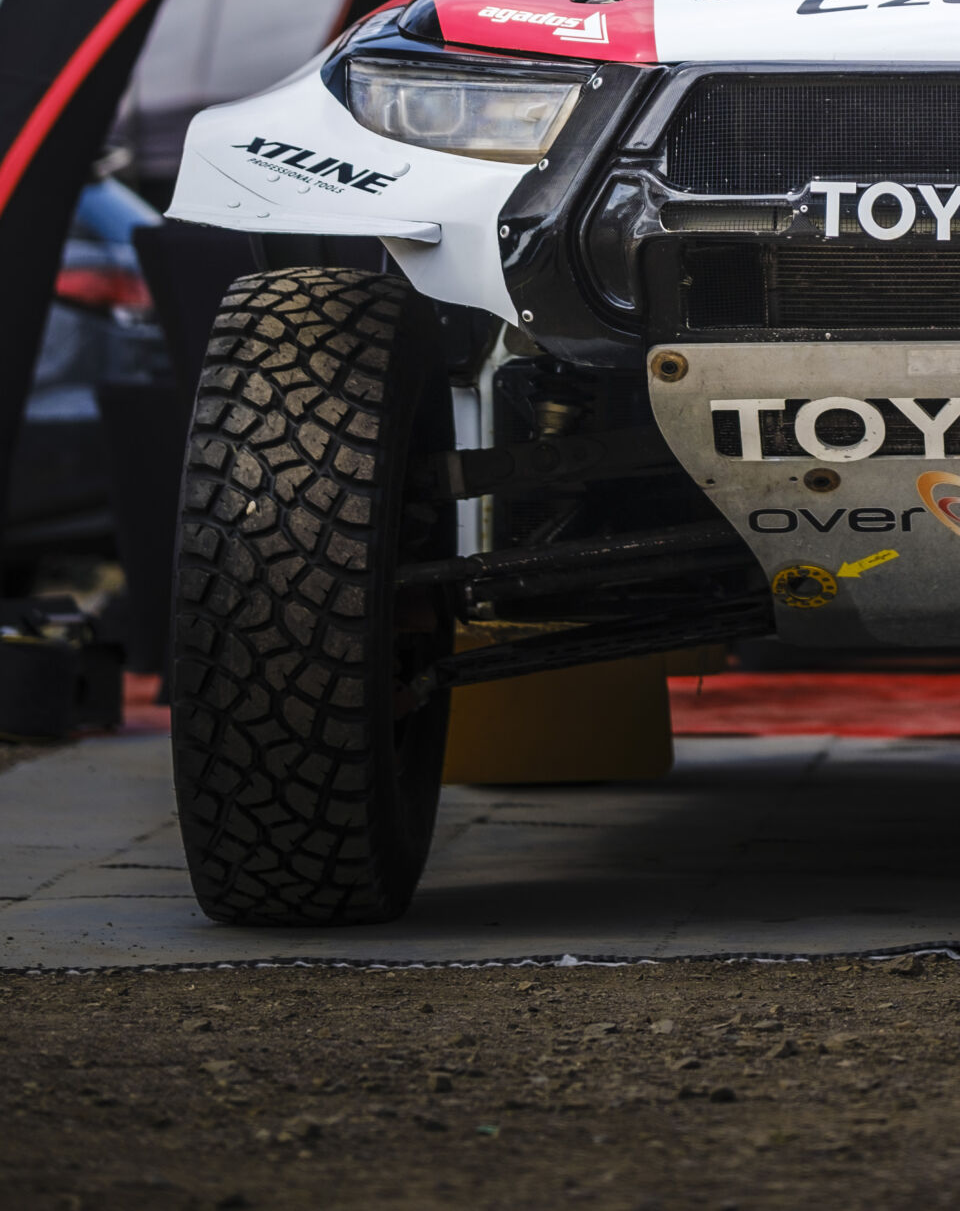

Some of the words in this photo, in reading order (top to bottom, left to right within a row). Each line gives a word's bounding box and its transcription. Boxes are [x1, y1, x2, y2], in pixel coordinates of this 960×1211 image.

[478, 5, 583, 28] agados
[231, 137, 398, 194] XTLINE
[248, 158, 312, 184] PROFESSIONAL
[315, 180, 345, 194] TOOLS
[748, 505, 930, 535] over
